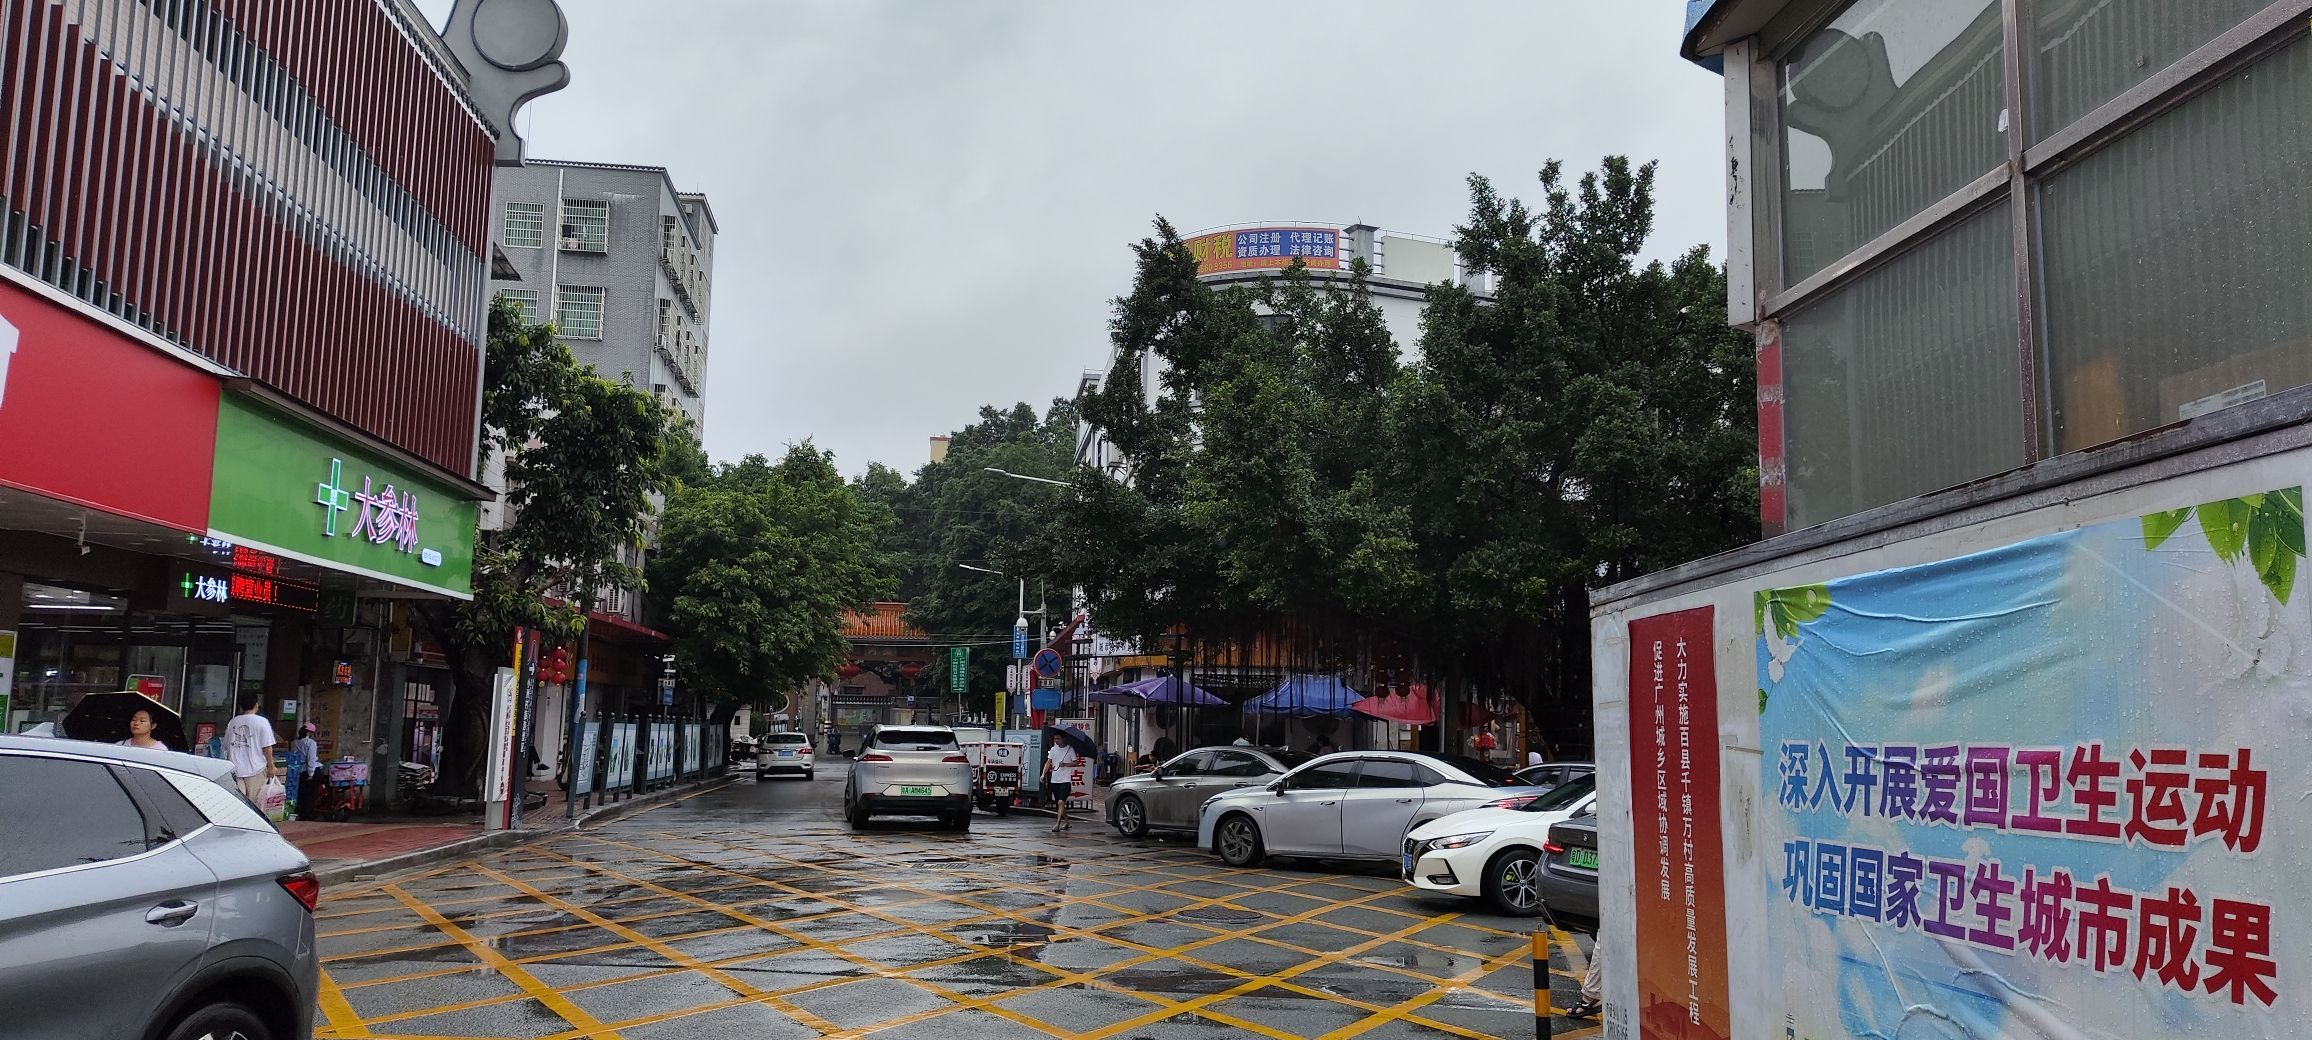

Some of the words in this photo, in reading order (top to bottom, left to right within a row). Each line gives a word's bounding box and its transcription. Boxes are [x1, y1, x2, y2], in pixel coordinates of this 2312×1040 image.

[1237, 232, 1281, 245] 公司注册
[1289, 232, 1335, 244] 代理记账
[1237, 244, 1281, 258] 资质办理
[1289, 244, 1334, 258] 法律咨询
[351, 475, 419, 553] 大参林
[194, 575, 228, 603] 大参林
[1652, 640, 1671, 902] 促进广州城乡区域协调发展
[1777, 742, 2268, 854] 深入开展爱国卫生运动
[1676, 636, 1701, 1026] 大力实施百县千镇万村高质量发展工程
[1782, 840, 2279, 1008] 巩固国家卫生城市成果
